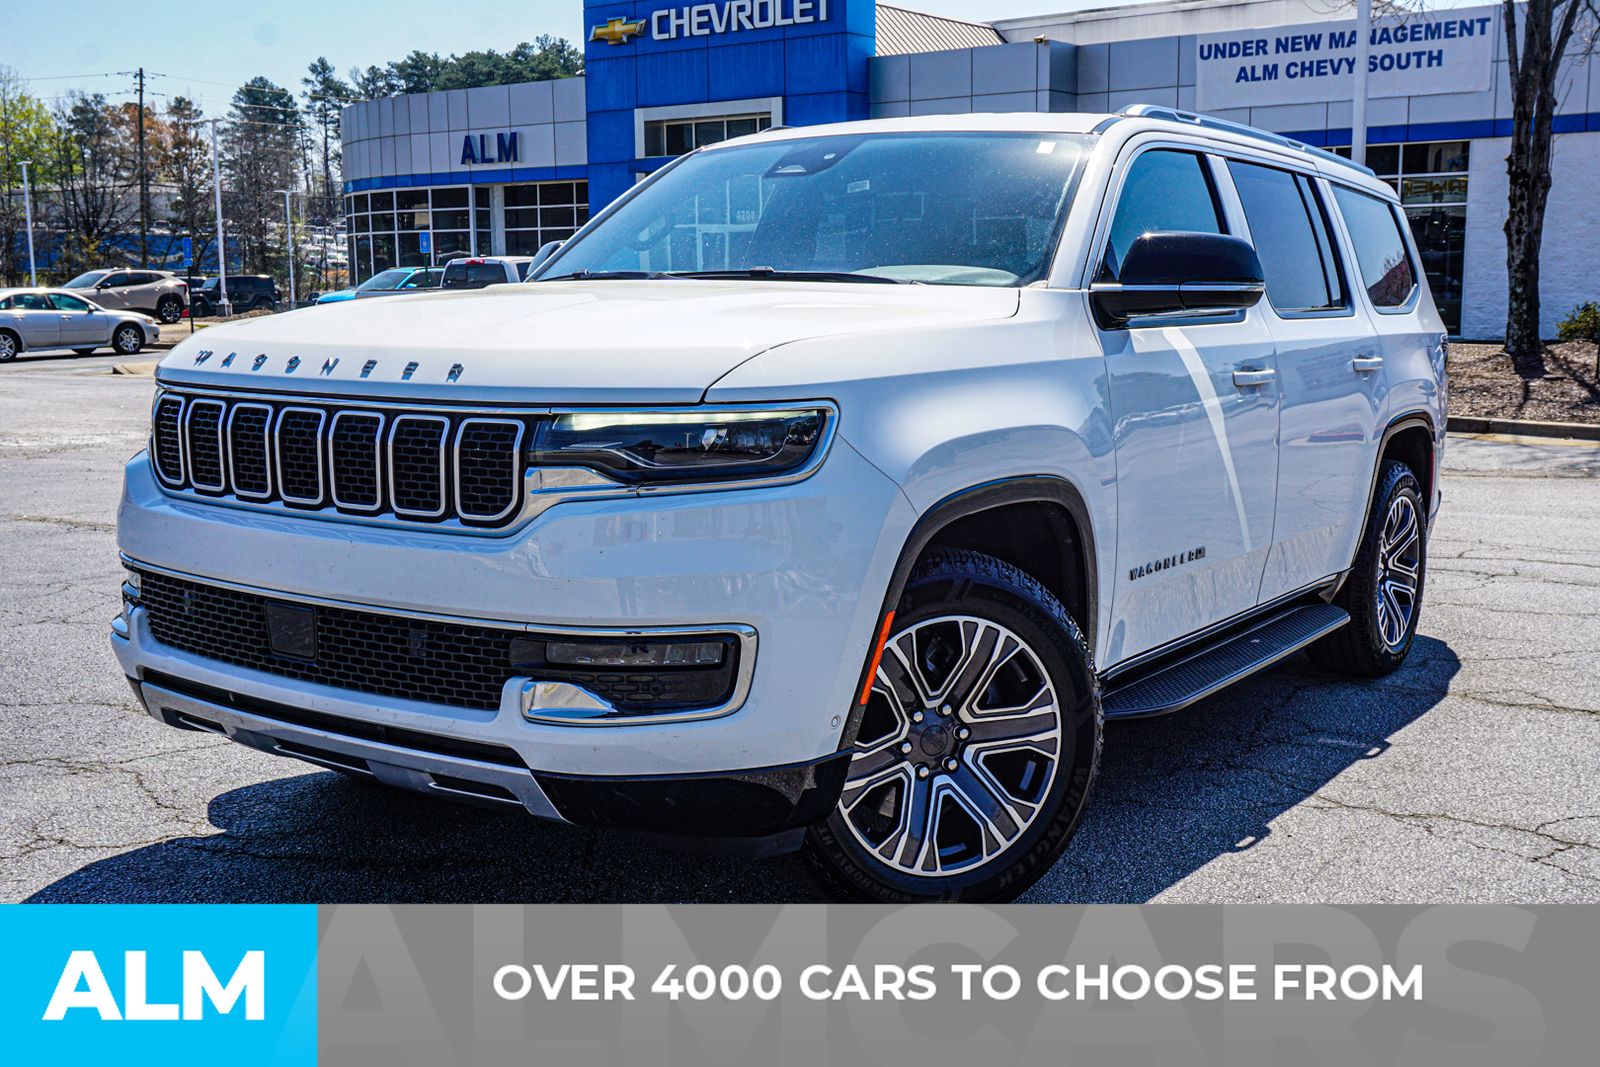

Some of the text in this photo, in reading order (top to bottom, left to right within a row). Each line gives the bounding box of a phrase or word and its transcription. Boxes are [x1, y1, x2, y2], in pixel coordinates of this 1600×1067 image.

[651, 0, 828, 41] CHEVROLET
[1199, 38, 1268, 60] UNDER
[1275, 33, 1323, 54] NEW
[1235, 49, 1443, 83] ALM CHEVY SOUTH
[461, 131, 518, 165] ALM
[193, 350, 465, 383] WAGONEER
[1129, 549, 1195, 581] WAGONEER
